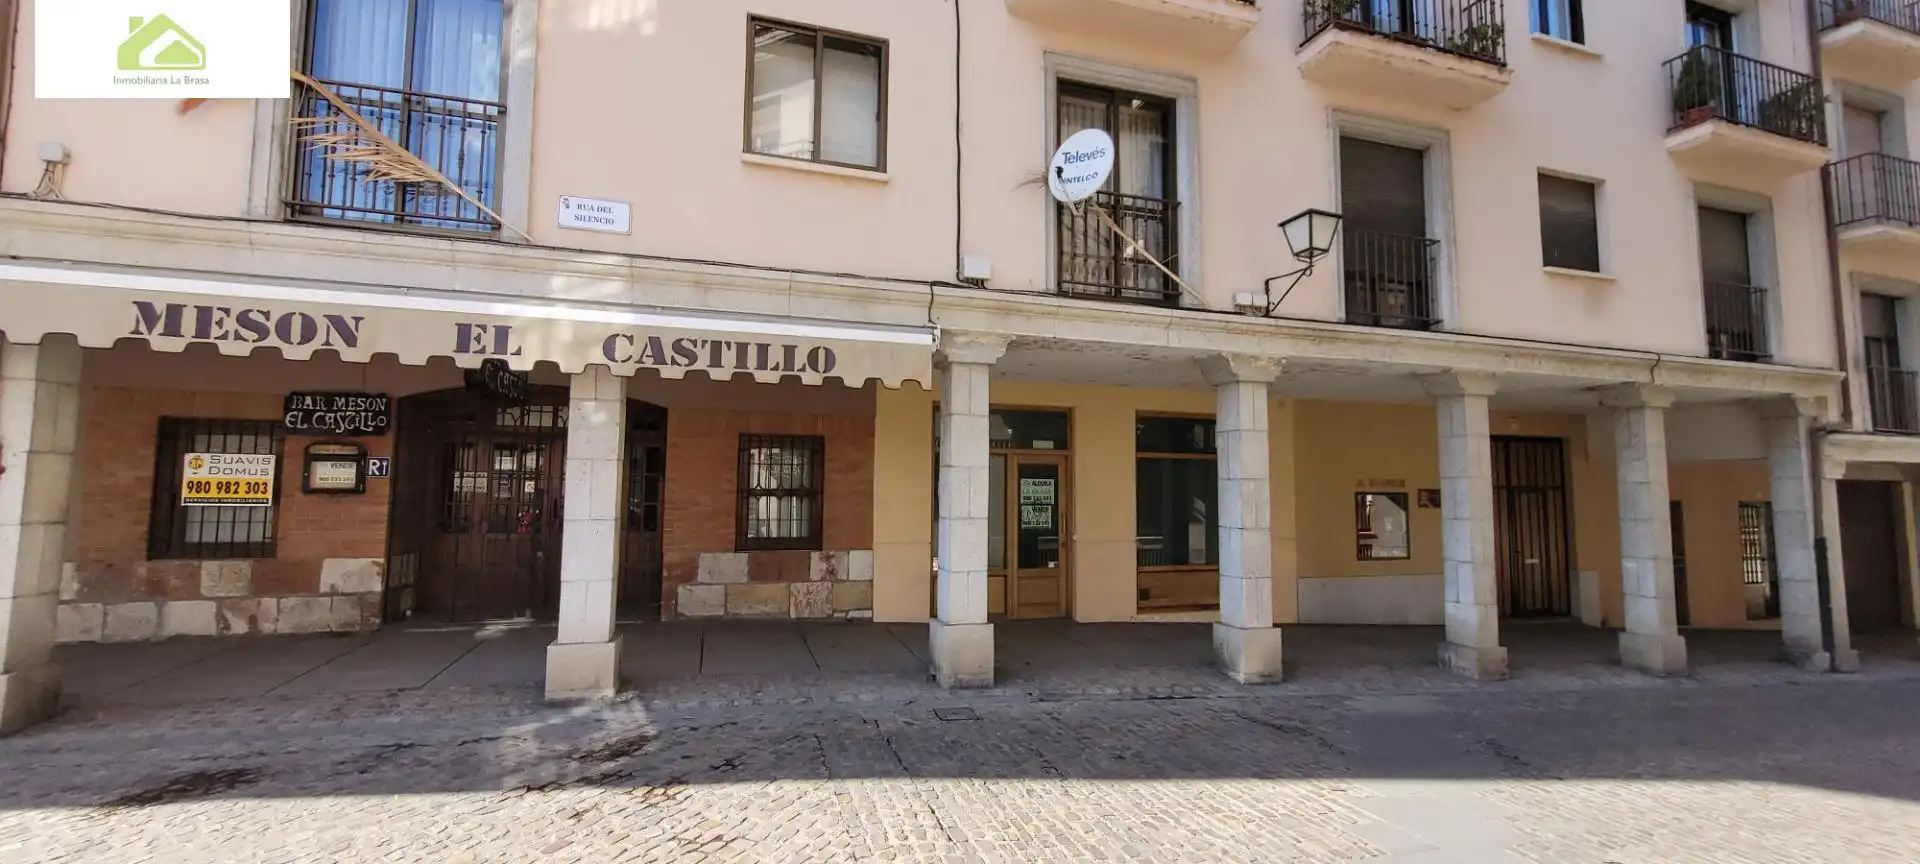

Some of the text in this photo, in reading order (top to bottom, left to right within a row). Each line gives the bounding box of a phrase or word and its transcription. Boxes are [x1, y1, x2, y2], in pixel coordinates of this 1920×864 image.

[1062, 146, 1107, 165] Televés
[577, 203, 614, 214] RUA DEL
[574, 213, 615, 225] SILENCIO
[129, 301, 837, 375] MESON EL CASTILLO
[291, 395, 387, 411] BAR MESON
[285, 411, 308, 429] EL
[210, 455, 271, 465] SUAVIS
[208, 466, 269, 476] DOMUS
[187, 480, 268, 495] 980 982 303
